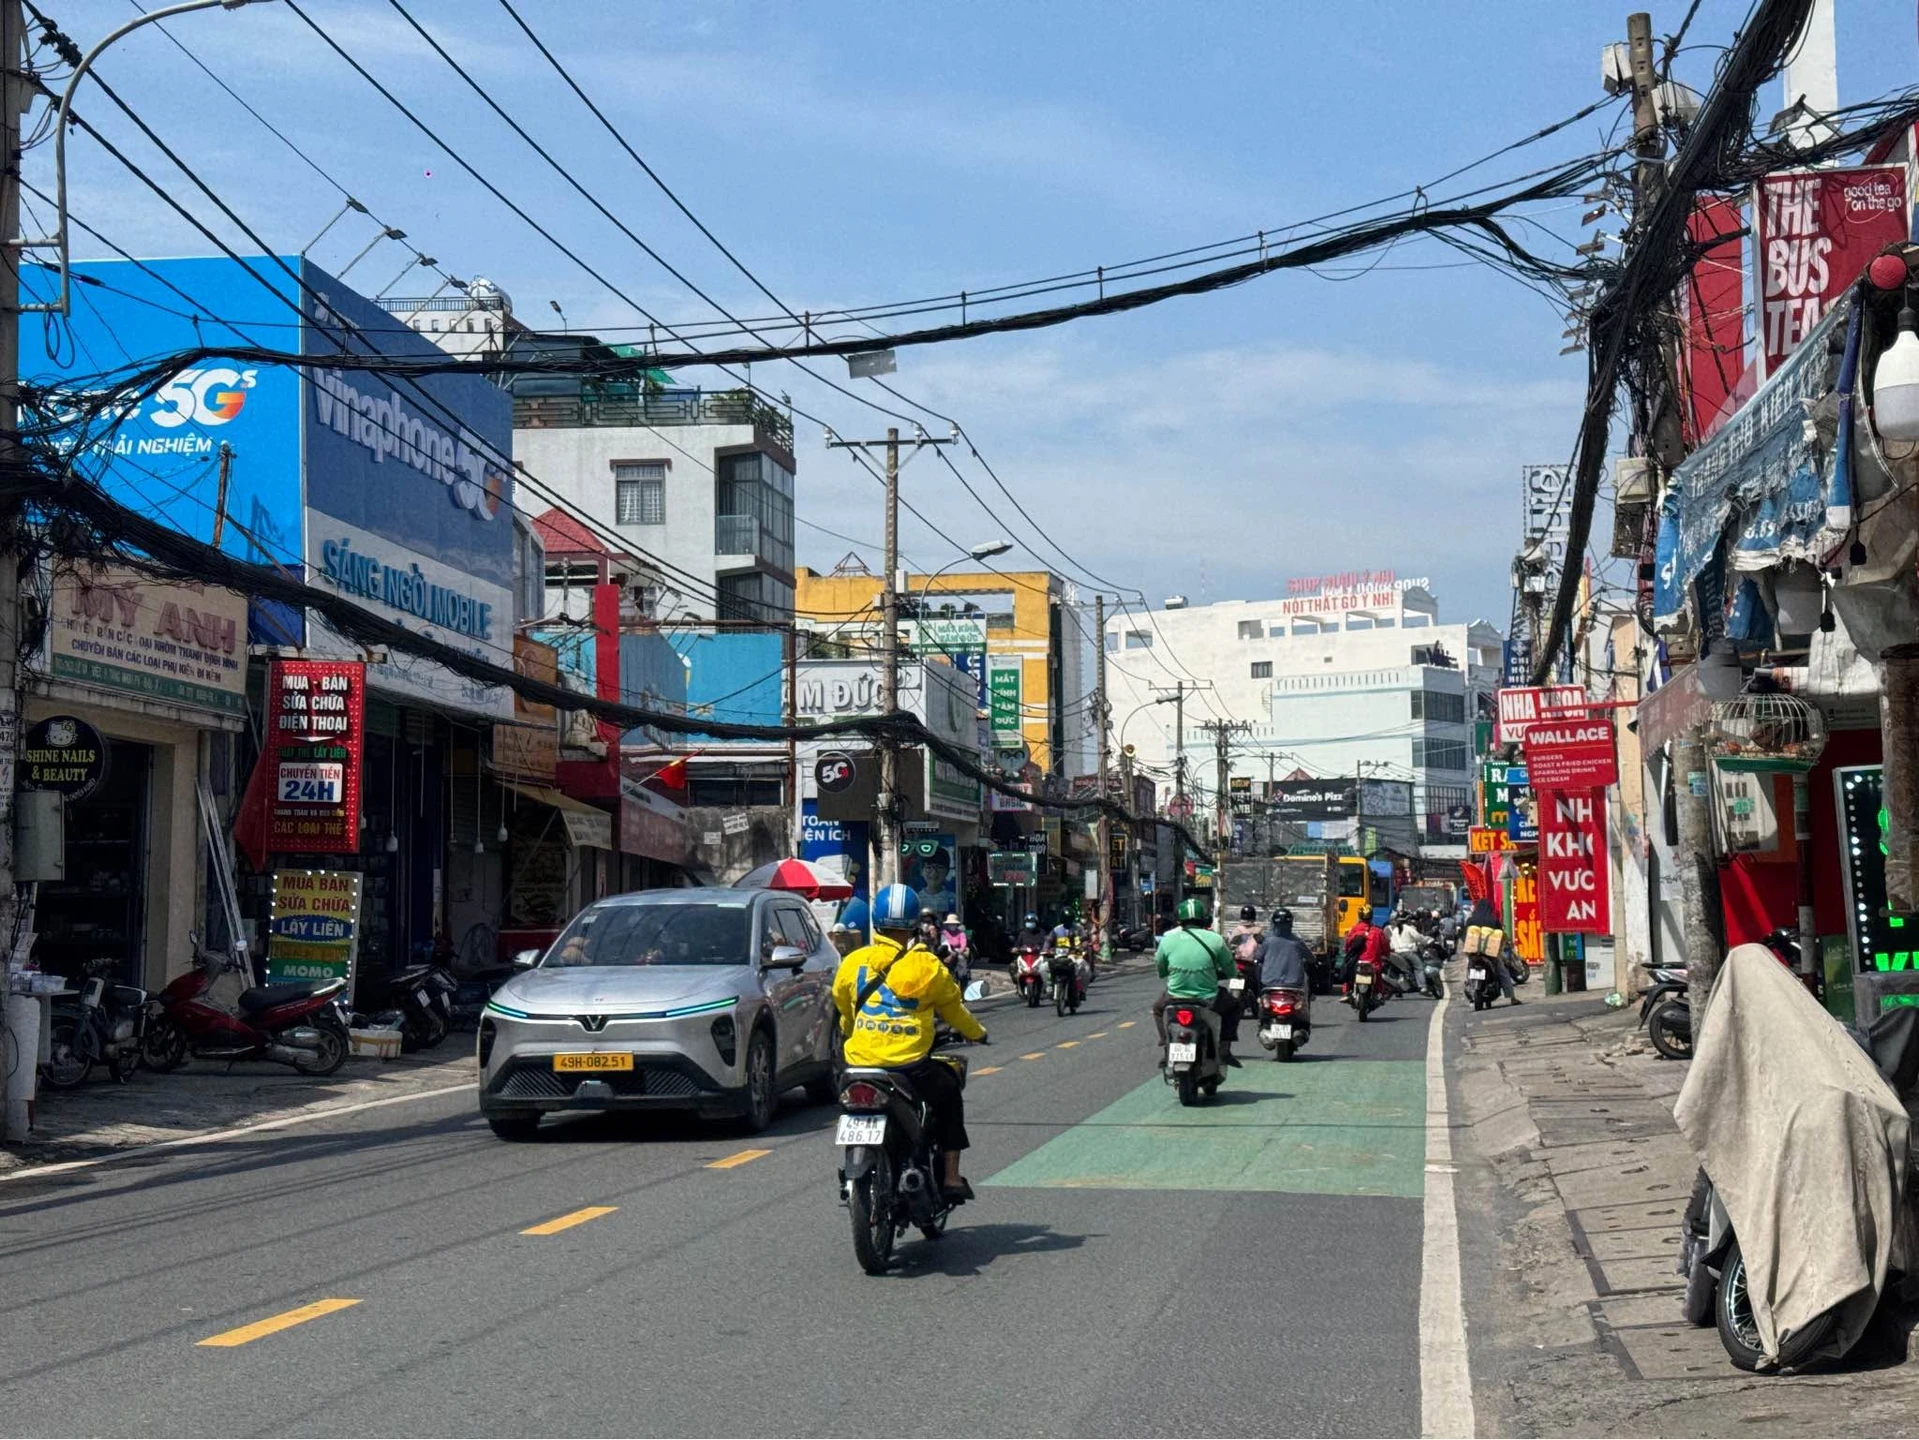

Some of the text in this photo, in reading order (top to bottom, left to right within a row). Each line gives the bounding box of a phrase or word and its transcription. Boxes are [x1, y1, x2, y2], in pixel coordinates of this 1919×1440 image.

[1844, 181, 1892, 200] good tea
[1764, 178, 1822, 239] THE
[1851, 197, 1902, 213] on the go
[1765, 237, 1832, 298] BUS
[137, 432, 213, 455] NGHIỆM
[322, 537, 380, 598] SÁNG
[431, 584, 493, 640] MOBILE
[153, 601, 237, 655] ANH
[282, 675, 309, 691] MUA
[321, 673, 348, 691] BÁN
[995, 672, 1016, 684] MẮT
[282, 691, 345, 711] SỬA CHỮA
[1502, 692, 1537, 722] NHA
[279, 714, 347, 734] ĐIỆN THOẠI
[1529, 726, 1609, 745] WALLACE
[25, 749, 96, 763] SHINE NAILS
[1562, 760, 1582, 768] FRIED
[1582, 758, 1612, 766] CHICKEN
[31, 764, 88, 782] & BEAUTY
[822, 761, 850, 784] 5G
[1533, 766, 1596, 777] SPARKLING DRINKS
[1546, 775, 1570, 783] CREAM
[284, 780, 335, 801] 24H
[1283, 791, 1323, 803] Domino's
[282, 875, 314, 891] MUA
[311, 895, 351, 913] CHỮA
[280, 918, 344, 937] LẤY LIỀN
[283, 964, 334, 978] MOMO
[839, 1129, 883, 1143] 486.17
